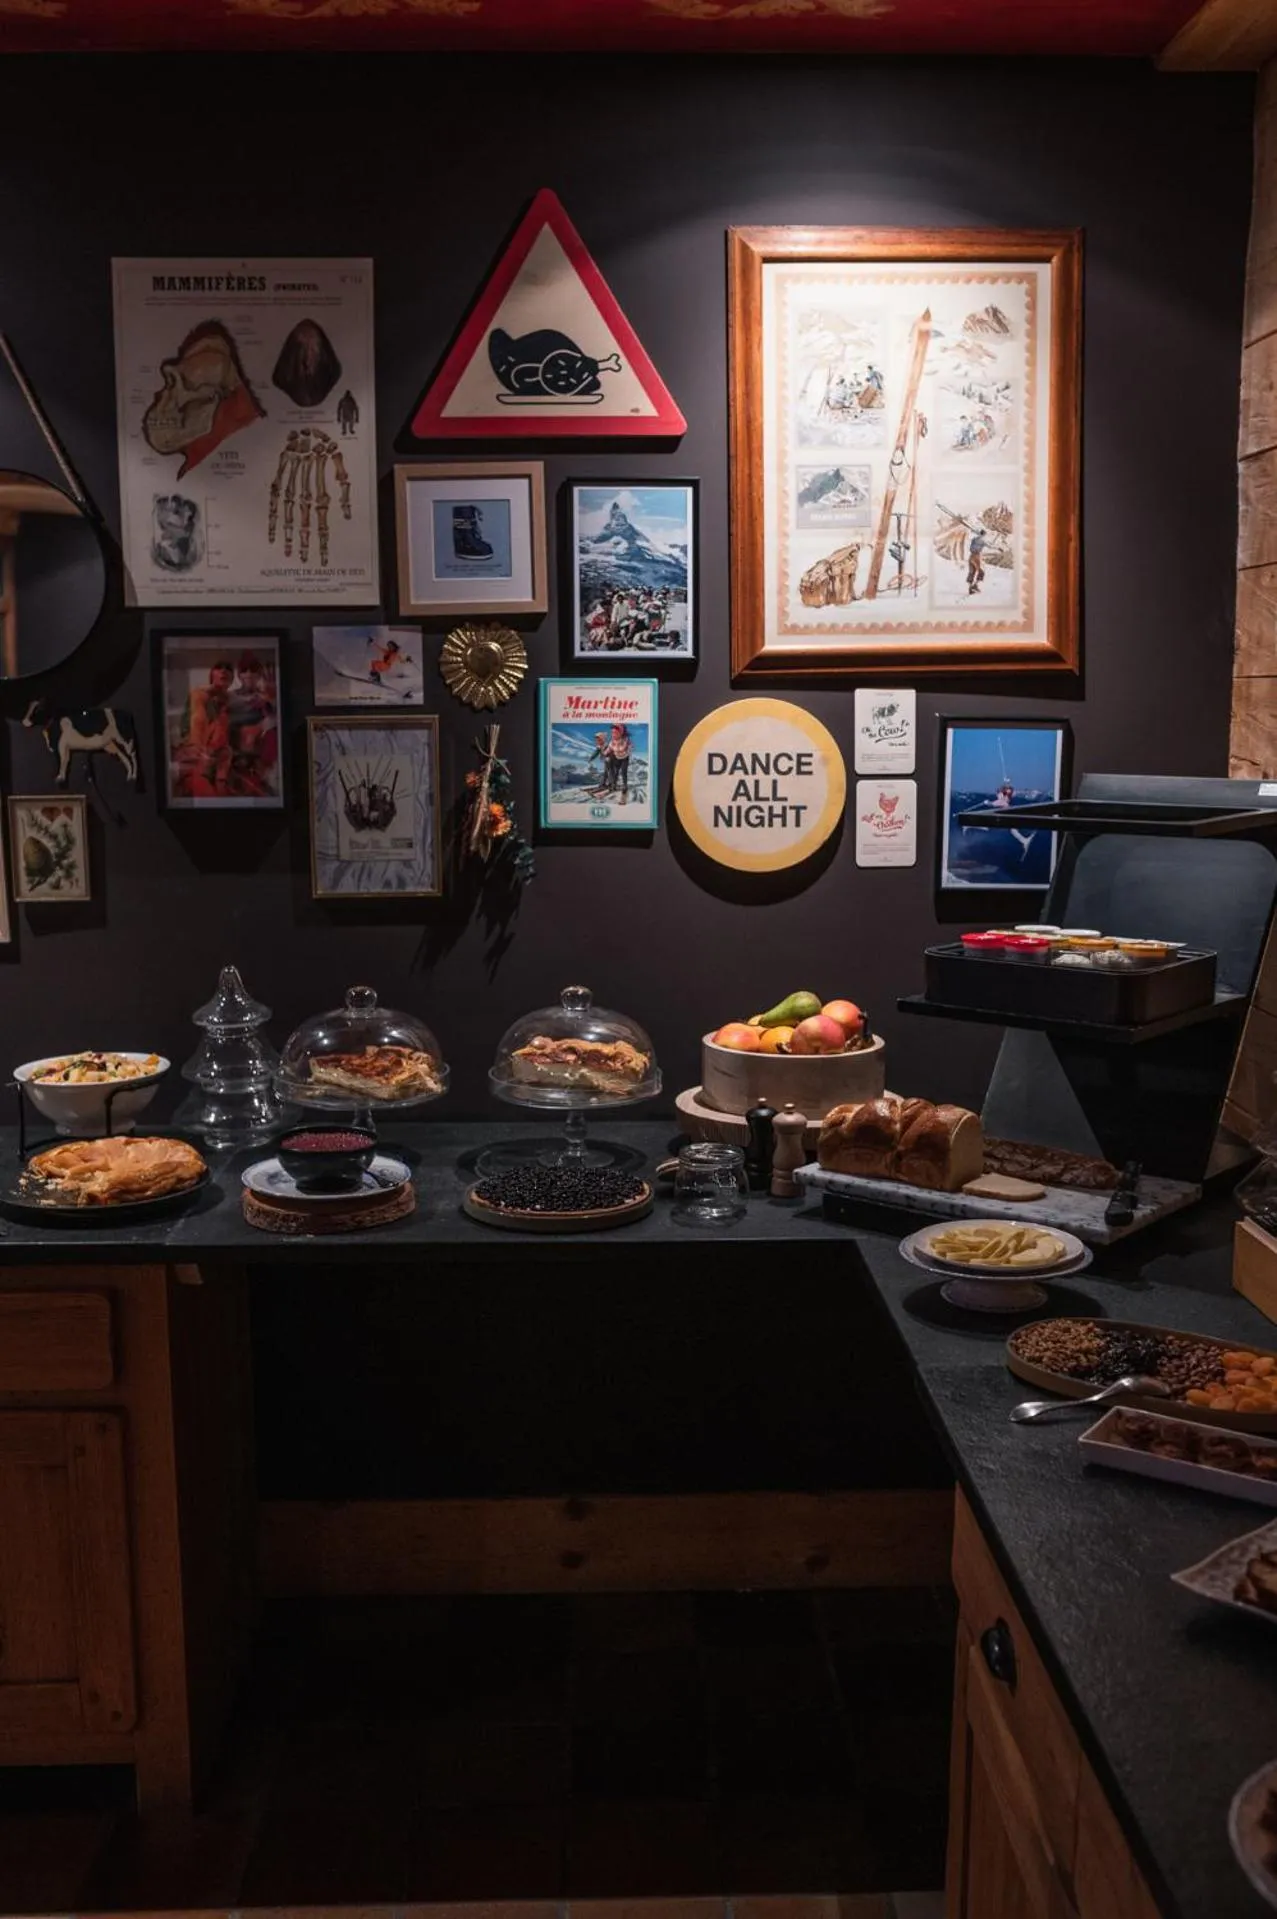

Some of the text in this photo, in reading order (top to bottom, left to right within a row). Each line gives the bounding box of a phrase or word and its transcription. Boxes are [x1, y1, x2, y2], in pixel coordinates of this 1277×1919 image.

[152, 271, 267, 291] MAMMIFÈRES
[563, 695, 638, 710] Martine
[572, 711, 582, 719] la
[585, 710, 638, 720] montagne
[707, 752, 814, 776] DANCE
[731, 779, 788, 802] ALL
[713, 804, 808, 829] NIGHT
